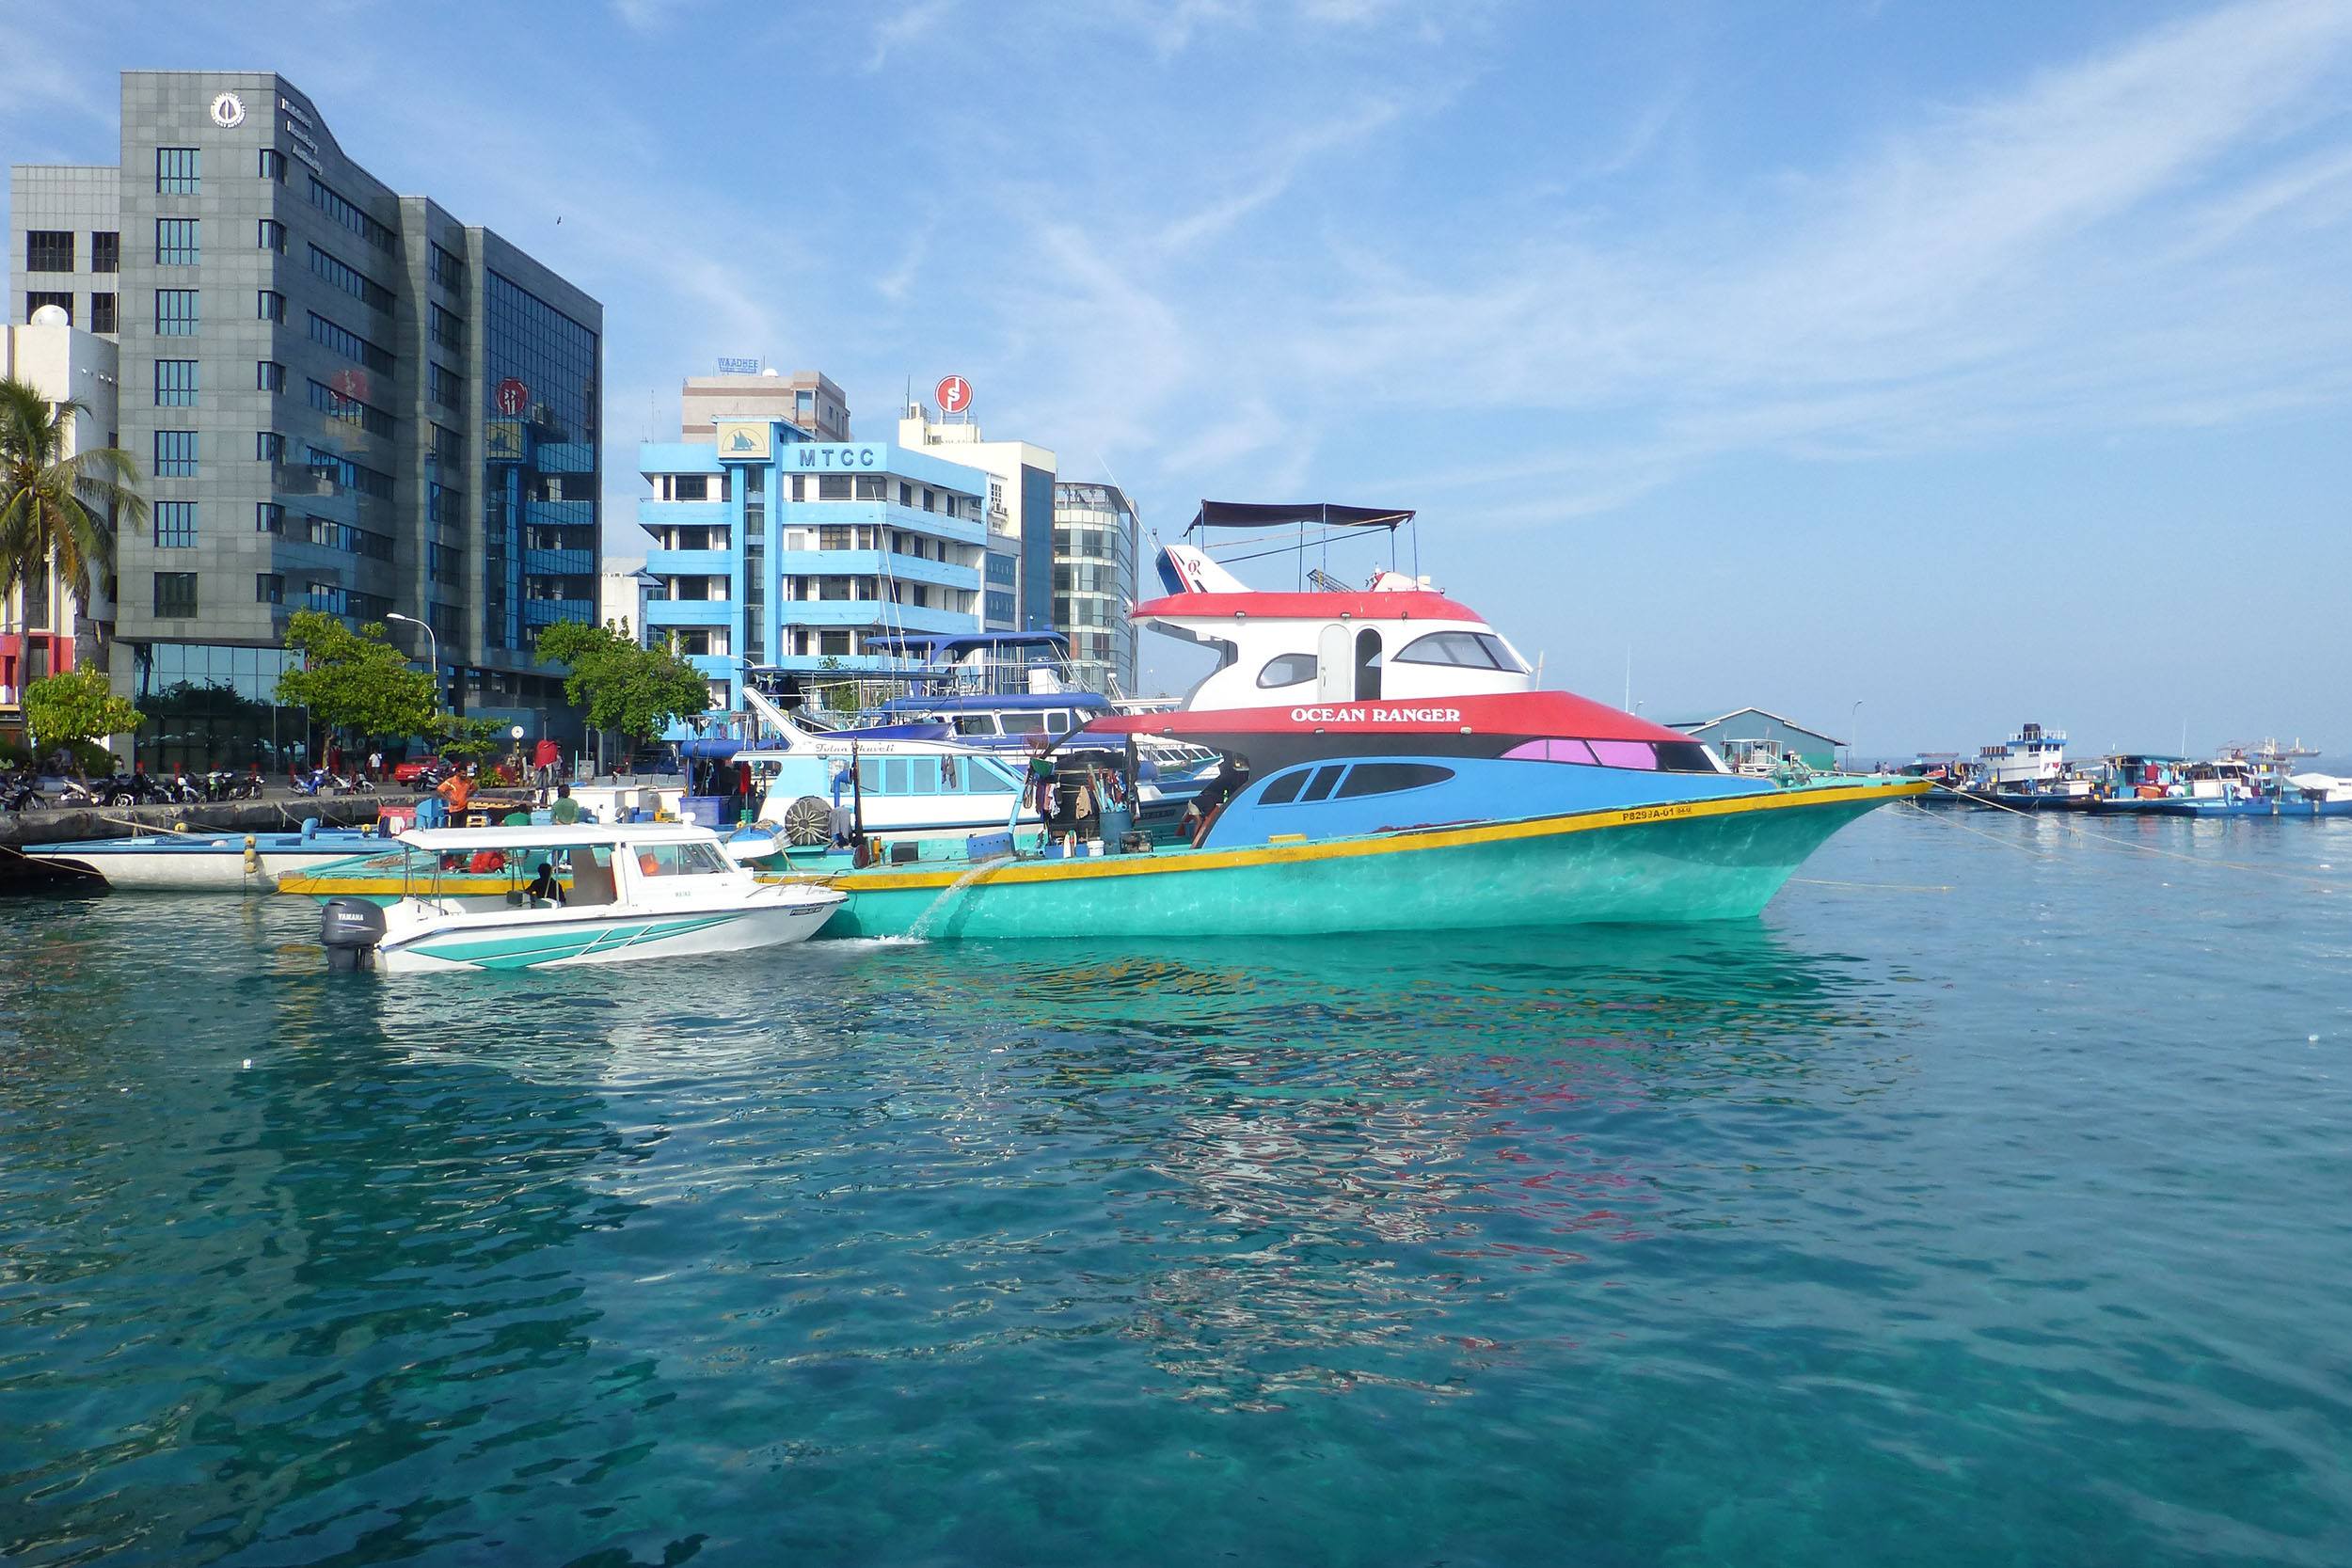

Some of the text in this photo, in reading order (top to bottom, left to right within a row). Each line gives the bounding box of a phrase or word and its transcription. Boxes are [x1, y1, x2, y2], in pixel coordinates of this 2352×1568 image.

[800, 449, 873, 467] MTCC
[1291, 708, 1460, 722] OCEAN RANGER
[338, 912, 364, 921] YAMAHA
